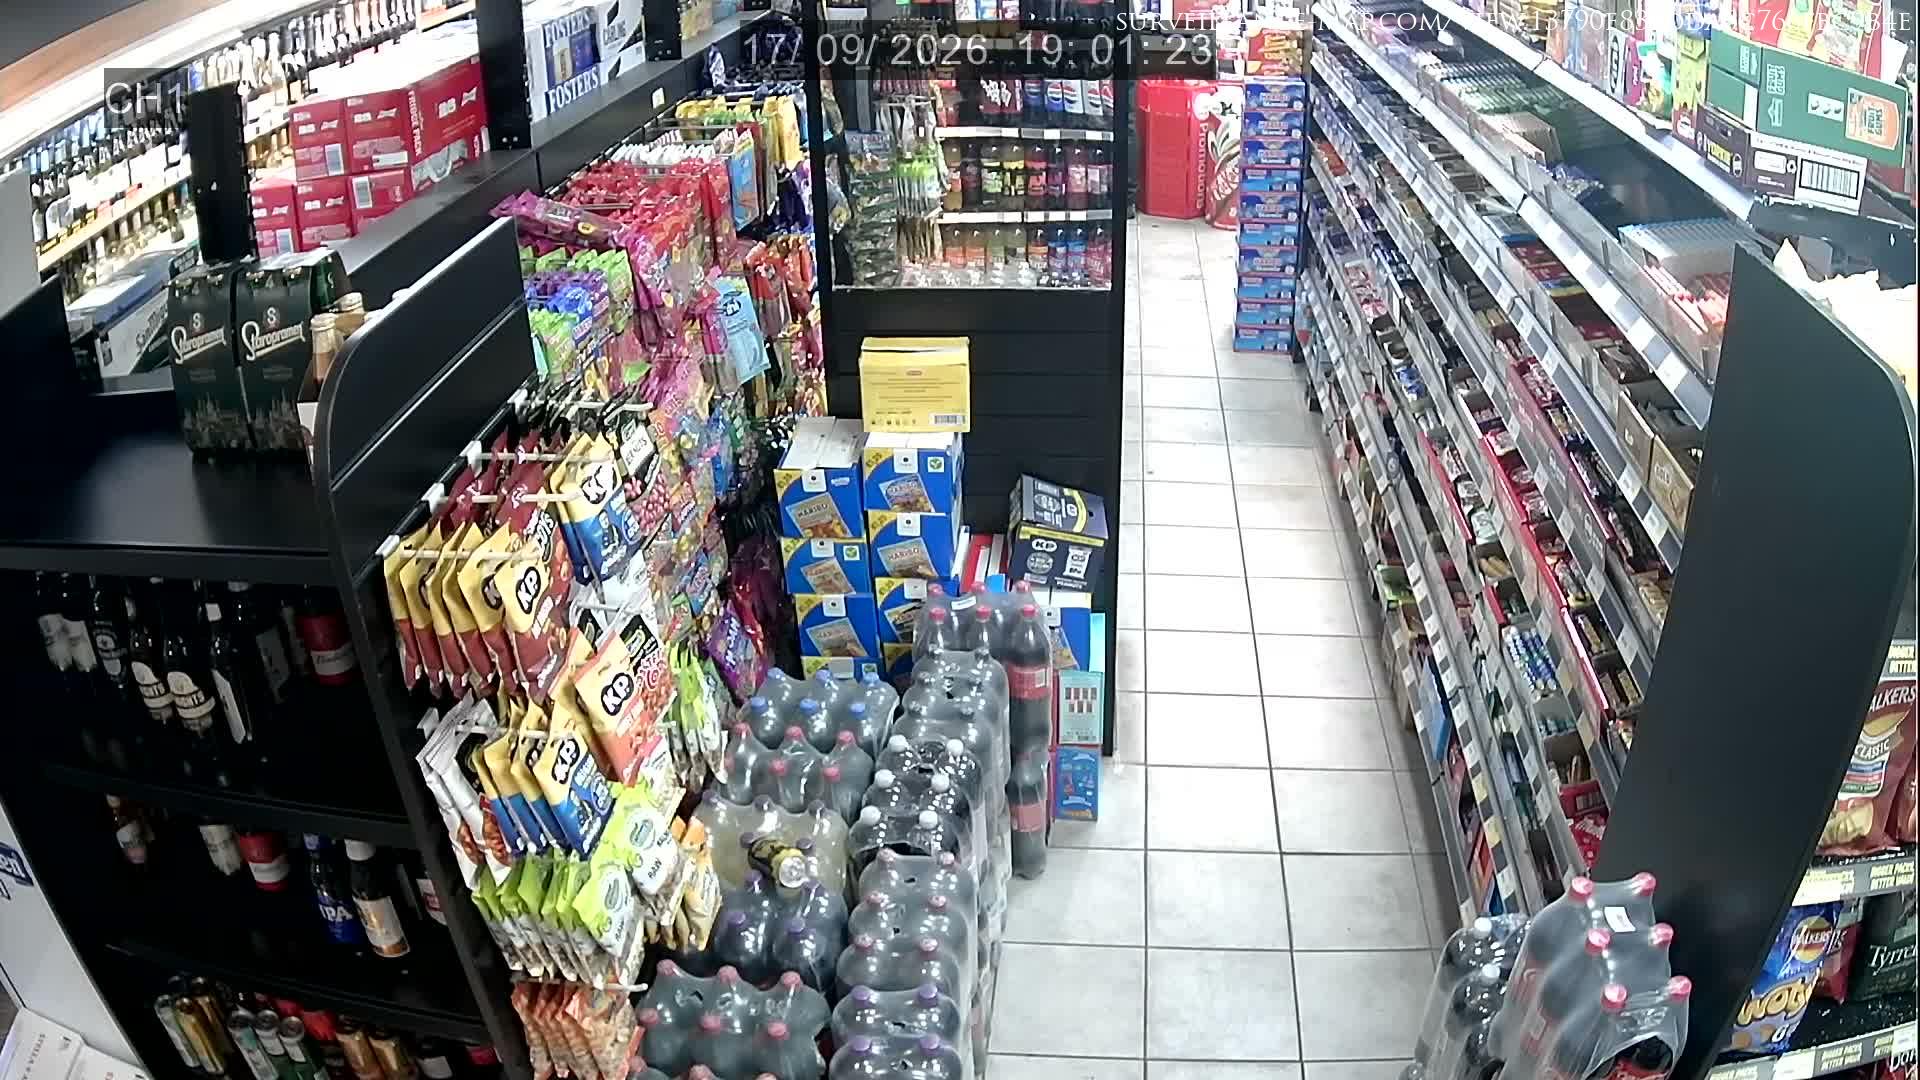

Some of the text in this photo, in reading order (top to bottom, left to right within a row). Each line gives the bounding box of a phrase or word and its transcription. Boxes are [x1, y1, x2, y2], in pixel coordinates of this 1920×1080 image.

[1033, 540, 1057, 551] KP
[516, 567, 541, 613] KP
[602, 673, 633, 715] KP
[552, 738, 579, 785] KP
[319, 904, 352, 922] IPA
